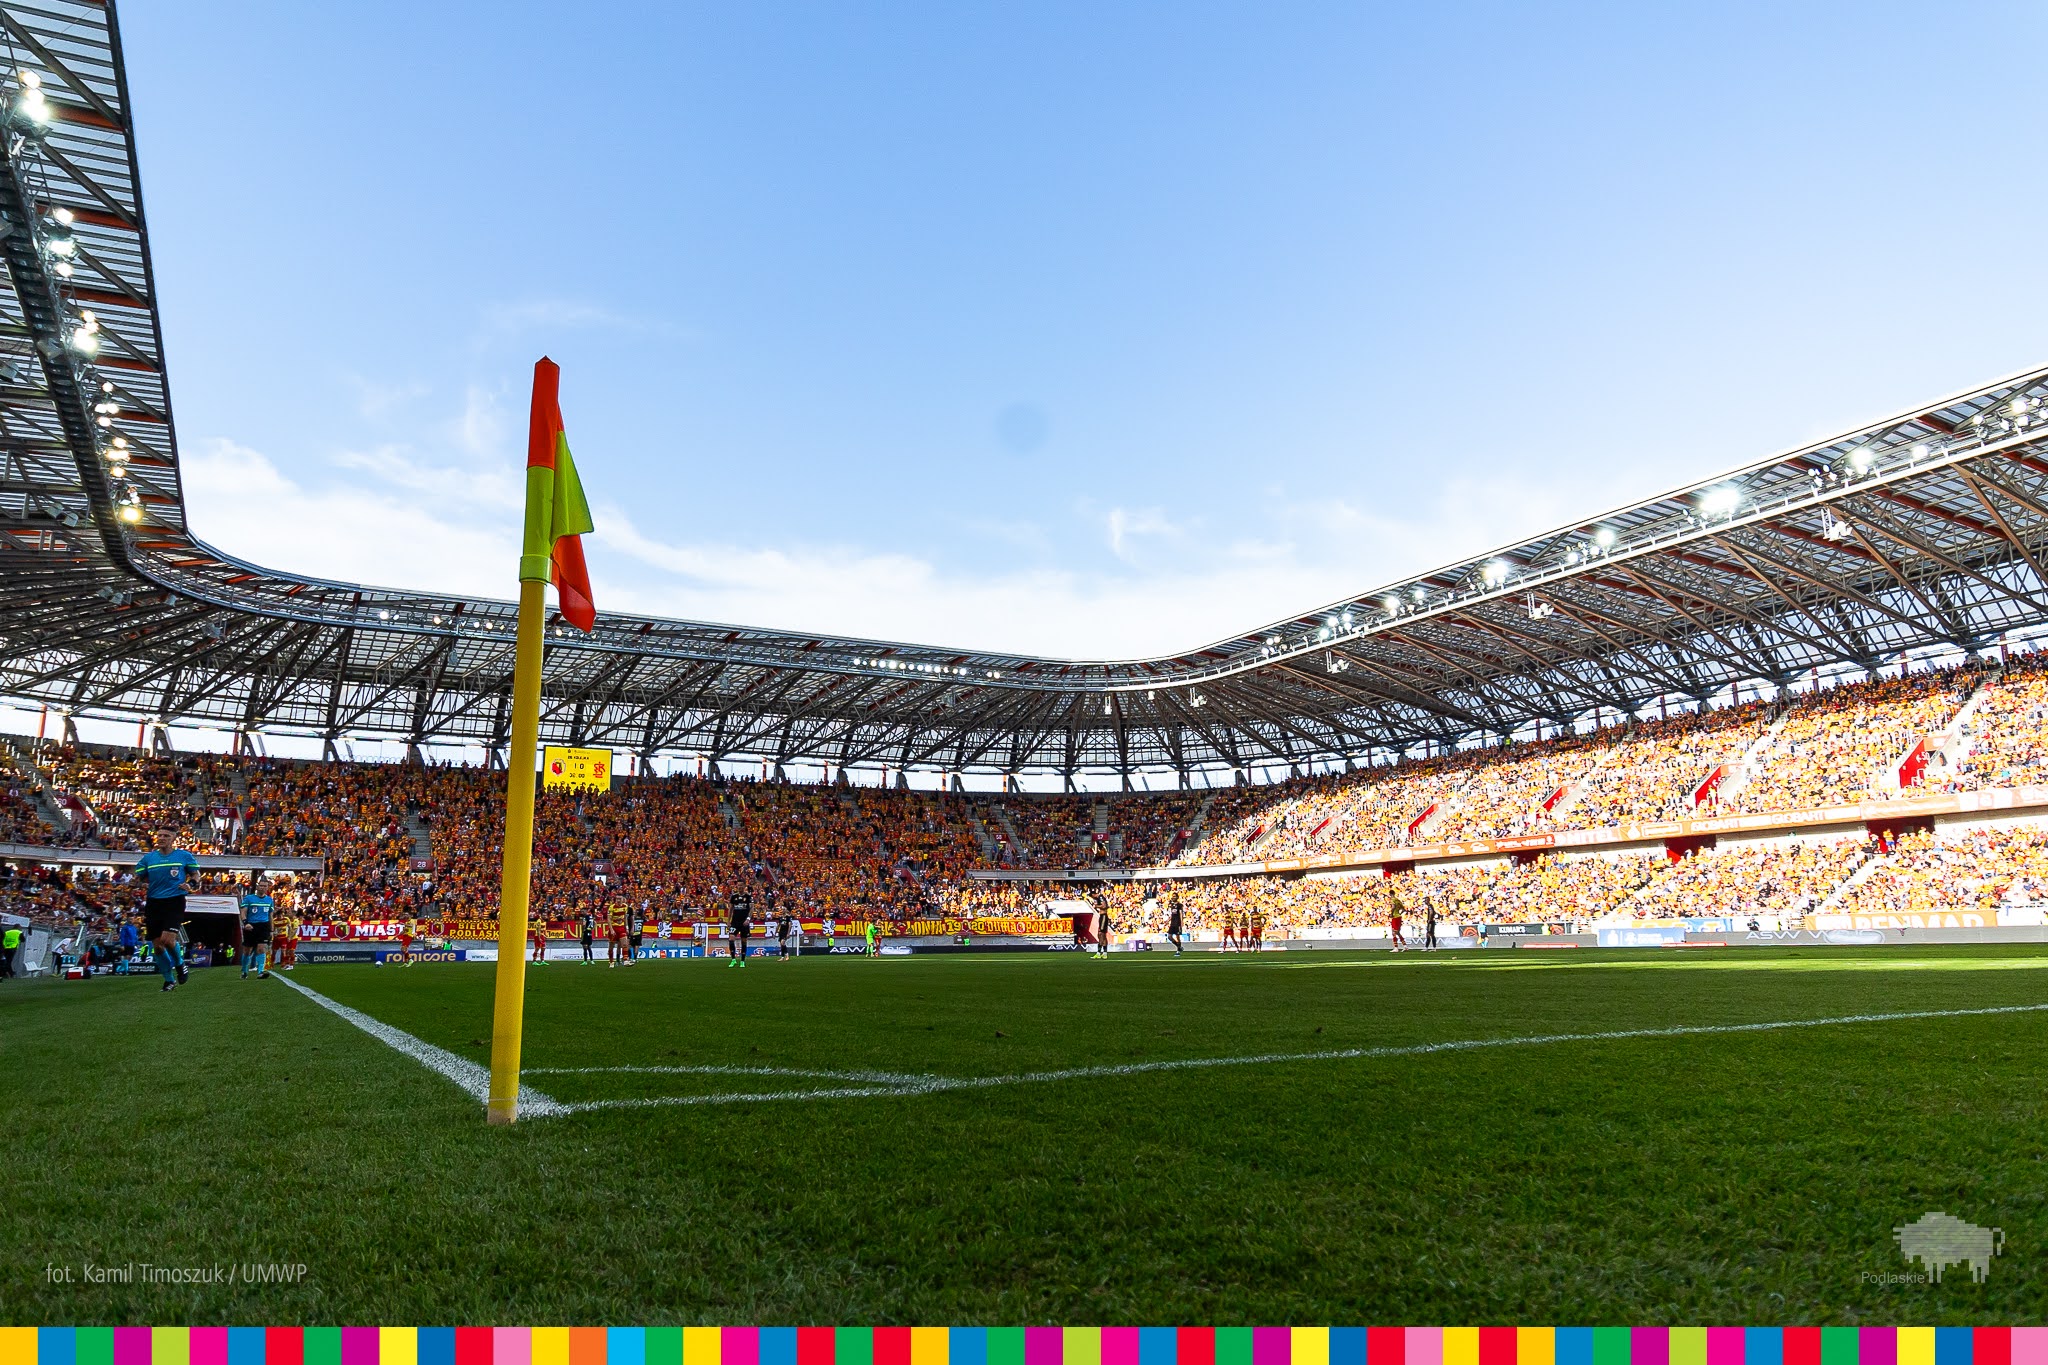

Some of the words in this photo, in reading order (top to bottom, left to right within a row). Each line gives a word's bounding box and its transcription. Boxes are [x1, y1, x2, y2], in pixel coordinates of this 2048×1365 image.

[295, 924, 329, 936] WE
[458, 922, 497, 930] BIELSK
[634, 922, 642, 931] 16
[449, 929, 499, 937] PODLASK
[1745, 930, 1801, 940] ASW
